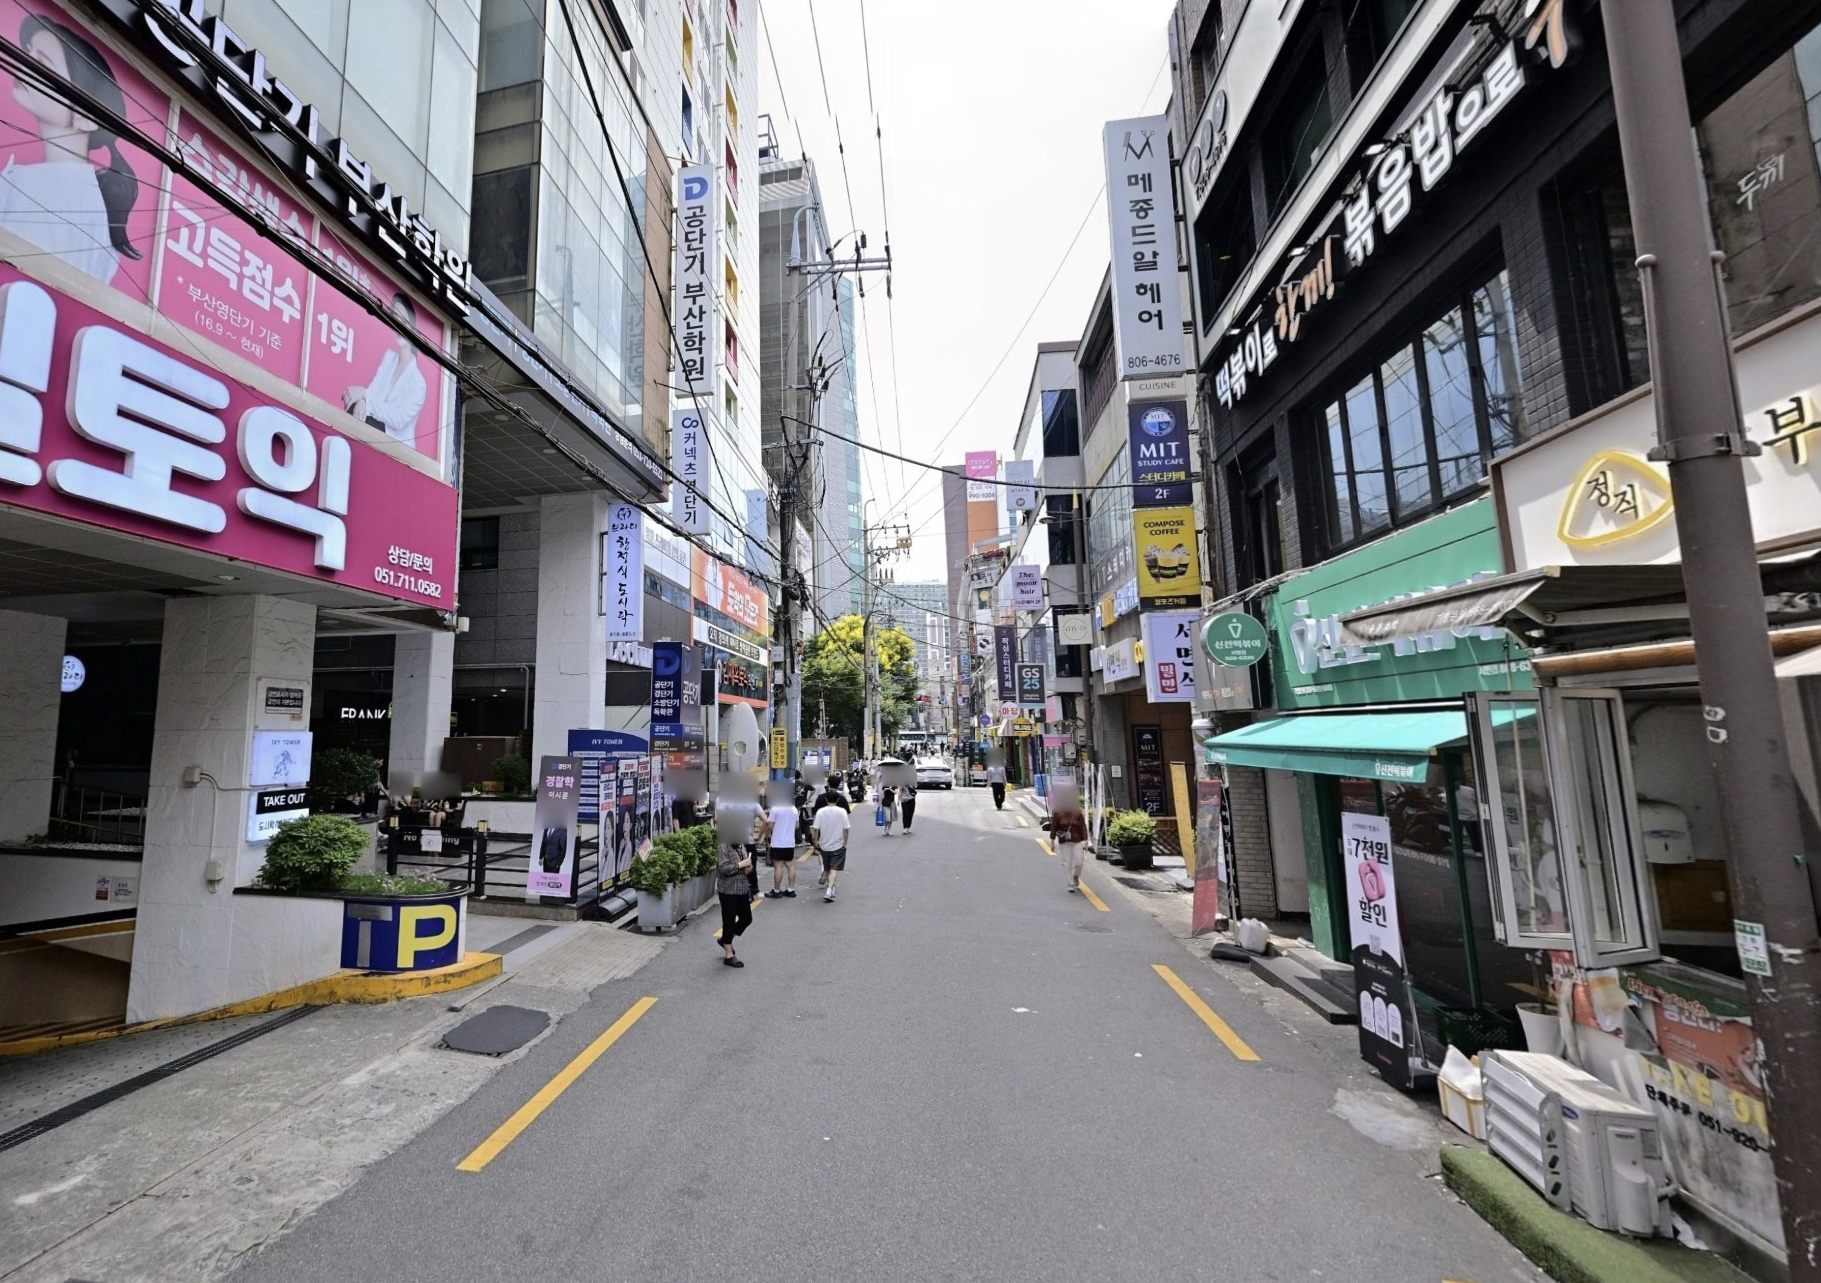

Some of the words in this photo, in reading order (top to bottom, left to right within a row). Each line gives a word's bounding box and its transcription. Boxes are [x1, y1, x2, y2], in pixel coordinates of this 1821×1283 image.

[1126, 172, 1160, 272] 메종드알
[1215, 321, 1279, 411] 떡볶이로
[1343, 38, 1527, 269] 볶음밥으로
[683, 204, 706, 276] 공단기
[166, 200, 301, 324] 고득점수
[1135, 281, 1164, 331] 헤어
[187, 283, 254, 336] 부산영단기
[258, 326, 283, 351] 기준
[317, 312, 355, 364] 1위
[682, 281, 706, 384] 부산학원
[240, 335, 264, 360] 현재)
[1127, 353, 1182, 369] 806-4676
[1138, 380, 1177, 391] CUISINE
[683, 430, 698, 476] 커넥츠
[1139, 441, 1181, 459] MIT
[1137, 459, 1163, 467] STUDY
[1138, 471, 1187, 482] 스터디카페
[1154, 488, 1171, 499] 2F
[1586, 469, 1641, 519] 정직
[1143, 519, 1186, 528] COMPOSE
[1149, 527, 1181, 536] COFFEE
[387, 544, 434, 575] 상담/문의
[615, 535, 630, 580] 한정식
[374, 565, 442, 600] 051.711.0582
[617, 582, 634, 628] 도시락
[1214, 639, 1262, 649] 신전떡볶이
[1001, 637, 1013, 689] 작심스터디카페
[1021, 667, 1040, 679] GS
[654, 681, 674, 689] 공단기
[1022, 678, 1040, 690] 25
[653, 699, 680, 707] 소방단기
[654, 690, 674, 698] 경단기
[653, 708, 674, 716] 독학관
[1380, 763, 1415, 778] 신전떡볶이
[545, 776, 575, 788] 경찰학
[263, 793, 286, 807] TAKE
[287, 792, 306, 804] OUT
[1146, 802, 1161, 813] 2F
[1351, 836, 1390, 866] 7천원
[1358, 896, 1388, 928] 할인
